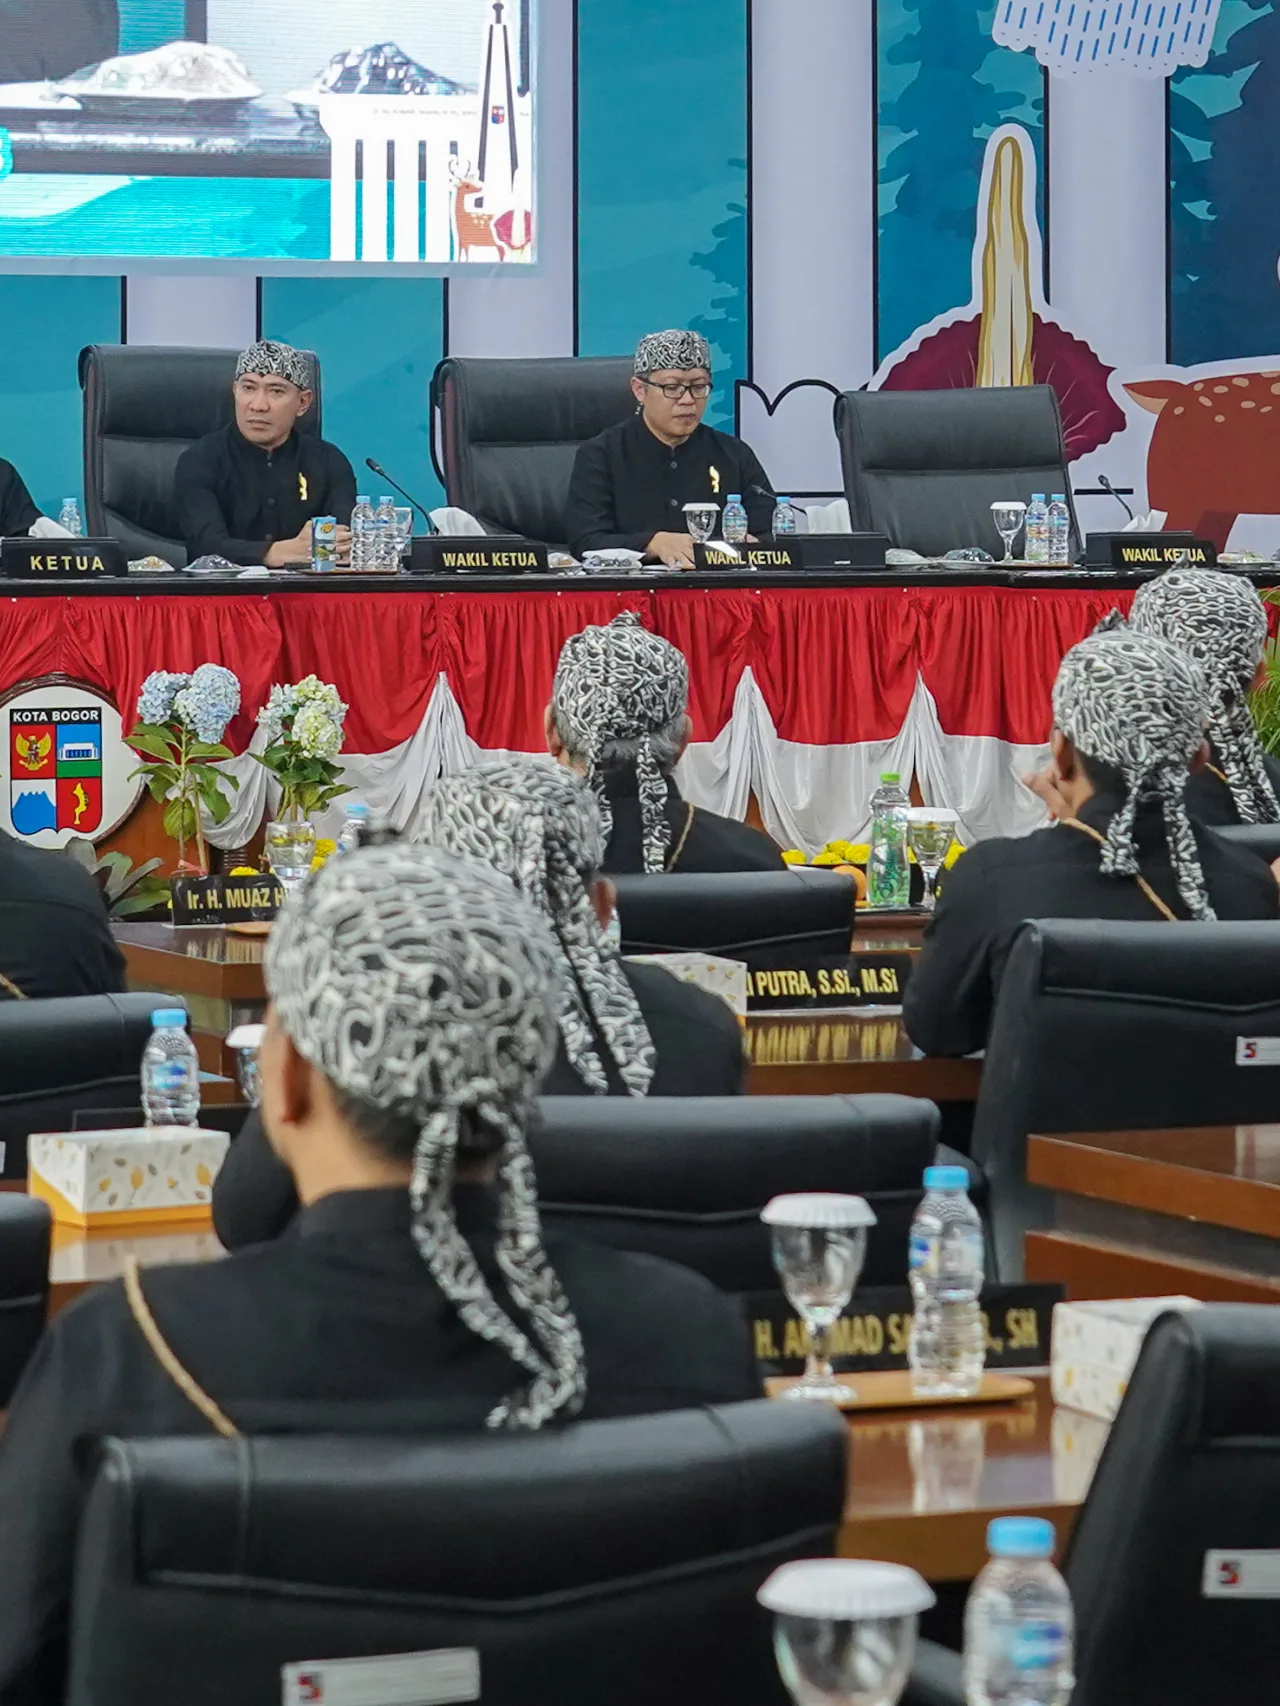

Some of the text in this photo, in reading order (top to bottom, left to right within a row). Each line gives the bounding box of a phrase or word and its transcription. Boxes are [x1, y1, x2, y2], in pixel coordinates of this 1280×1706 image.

[30, 555, 105, 572] KETUA
[442, 551, 538, 568] WAKIL KETUA
[748, 550, 792, 565] KETUA
[1122, 548, 1163, 562] WAKIL
[13, 710, 99, 722] KOTA BOGOR
[187, 889, 204, 910] Ir.
[206, 888, 223, 909] H.
[225, 887, 271, 909] MUAZ
[756, 970, 817, 998] PUTRA,
[818, 968, 861, 997] S.Si.,
[862, 967, 899, 993] M.Si
[753, 1319, 780, 1360] H.
[1005, 1307, 1039, 1350] SH
